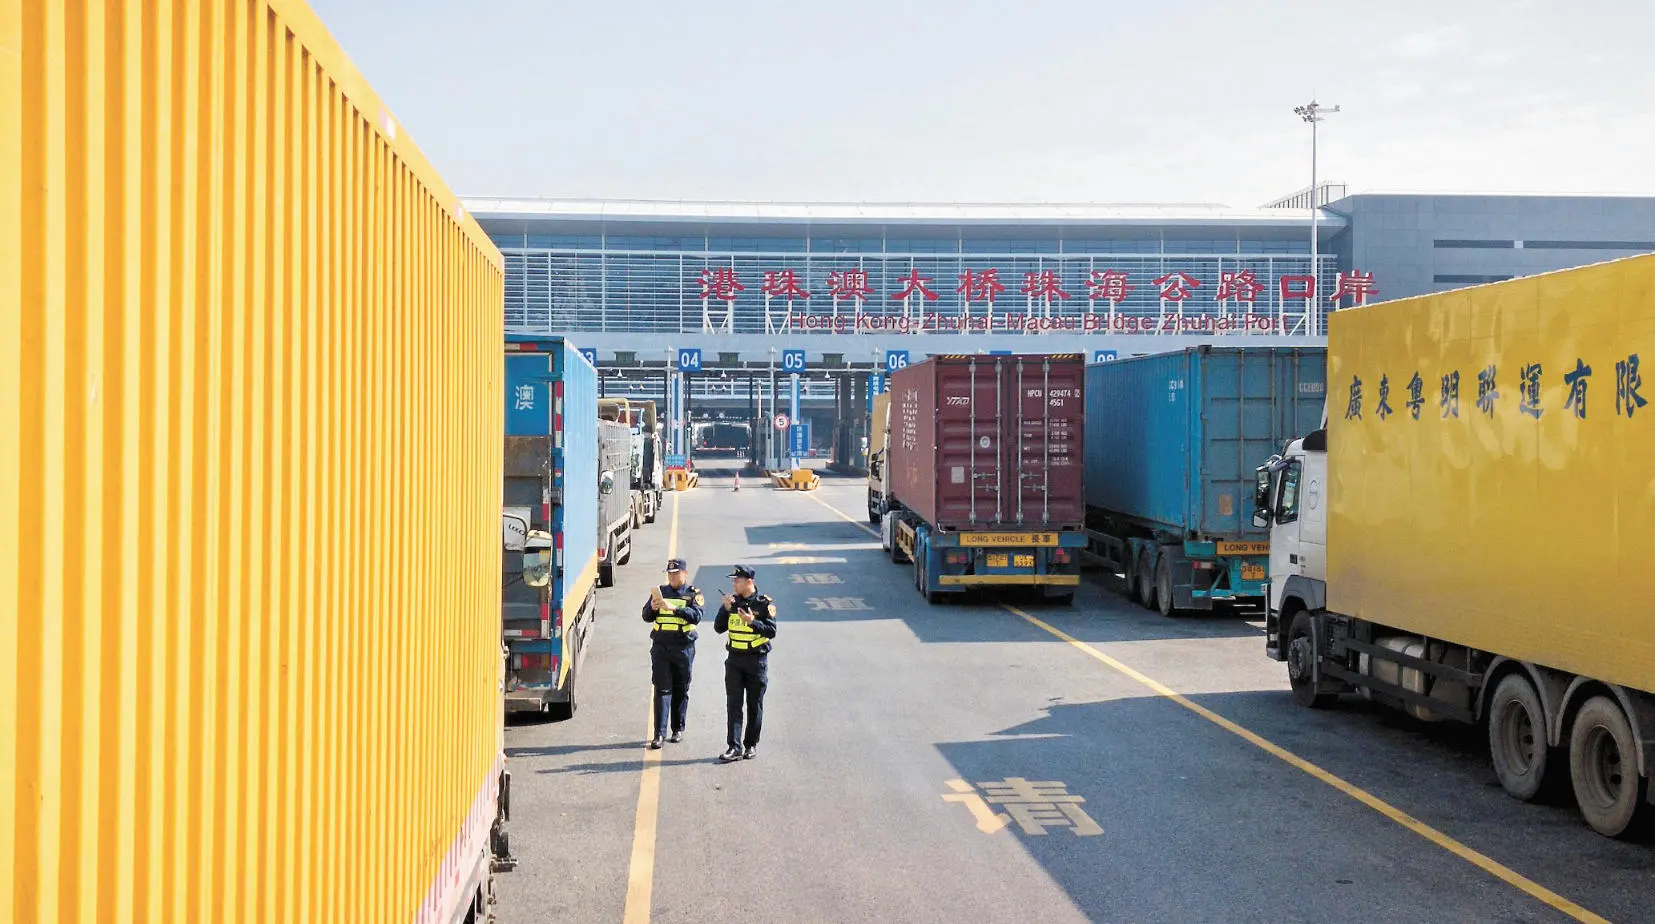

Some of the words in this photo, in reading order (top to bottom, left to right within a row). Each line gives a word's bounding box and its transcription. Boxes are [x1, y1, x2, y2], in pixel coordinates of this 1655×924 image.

[696, 267, 1380, 303] 港珠澳大桥珠海公路口岸
[788, 312, 846, 333] Hong
[1083, 311, 1153, 332] Bridge
[1161, 311, 1236, 330] Zhuhai
[1244, 311, 1289, 331] Port
[680, 351, 699, 368] 04
[785, 353, 803, 369] 05
[888, 354, 906, 369] 06
[515, 384, 534, 410] 澳
[778, 418, 785, 426] 5
[966, 535, 988, 543] LONG
[992, 535, 1025, 543] VEHICLE
[1224, 543, 1248, 551] LONG
[940, 777, 1105, 836] 请
